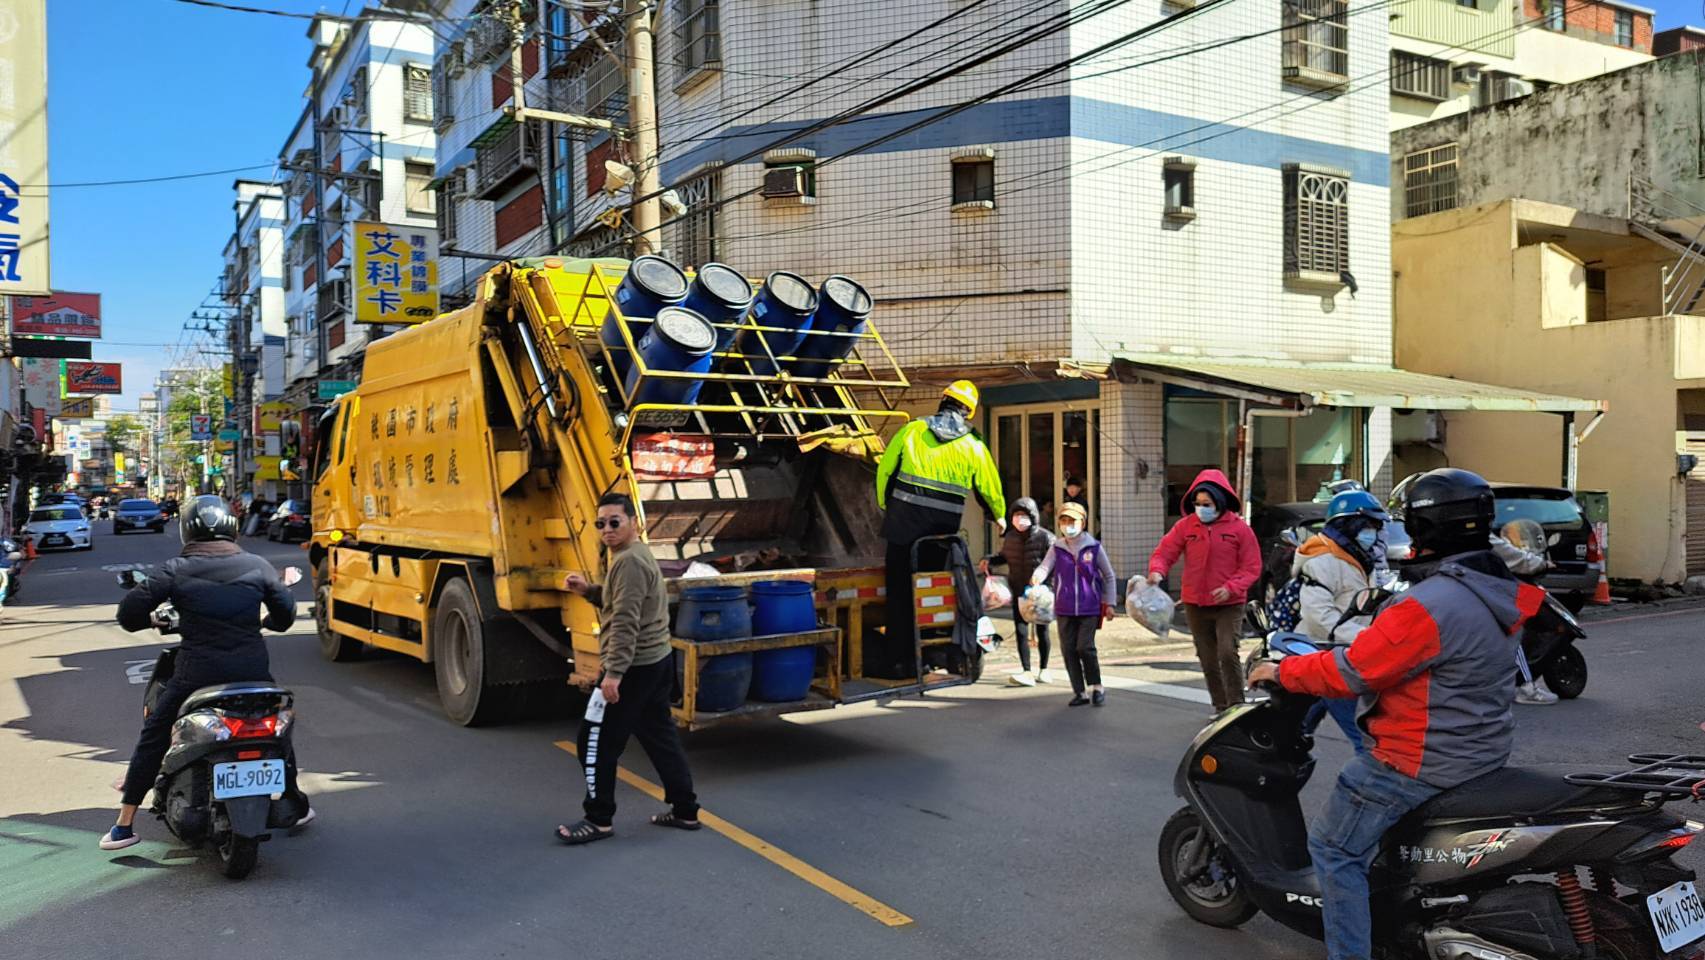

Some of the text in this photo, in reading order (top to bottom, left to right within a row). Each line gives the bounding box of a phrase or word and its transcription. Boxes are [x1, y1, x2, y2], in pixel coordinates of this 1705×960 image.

[365, 231, 402, 314] 艾科卡
[371, 397, 459, 441] 桃園市政府
[216, 769, 282, 790] MGL-9092
